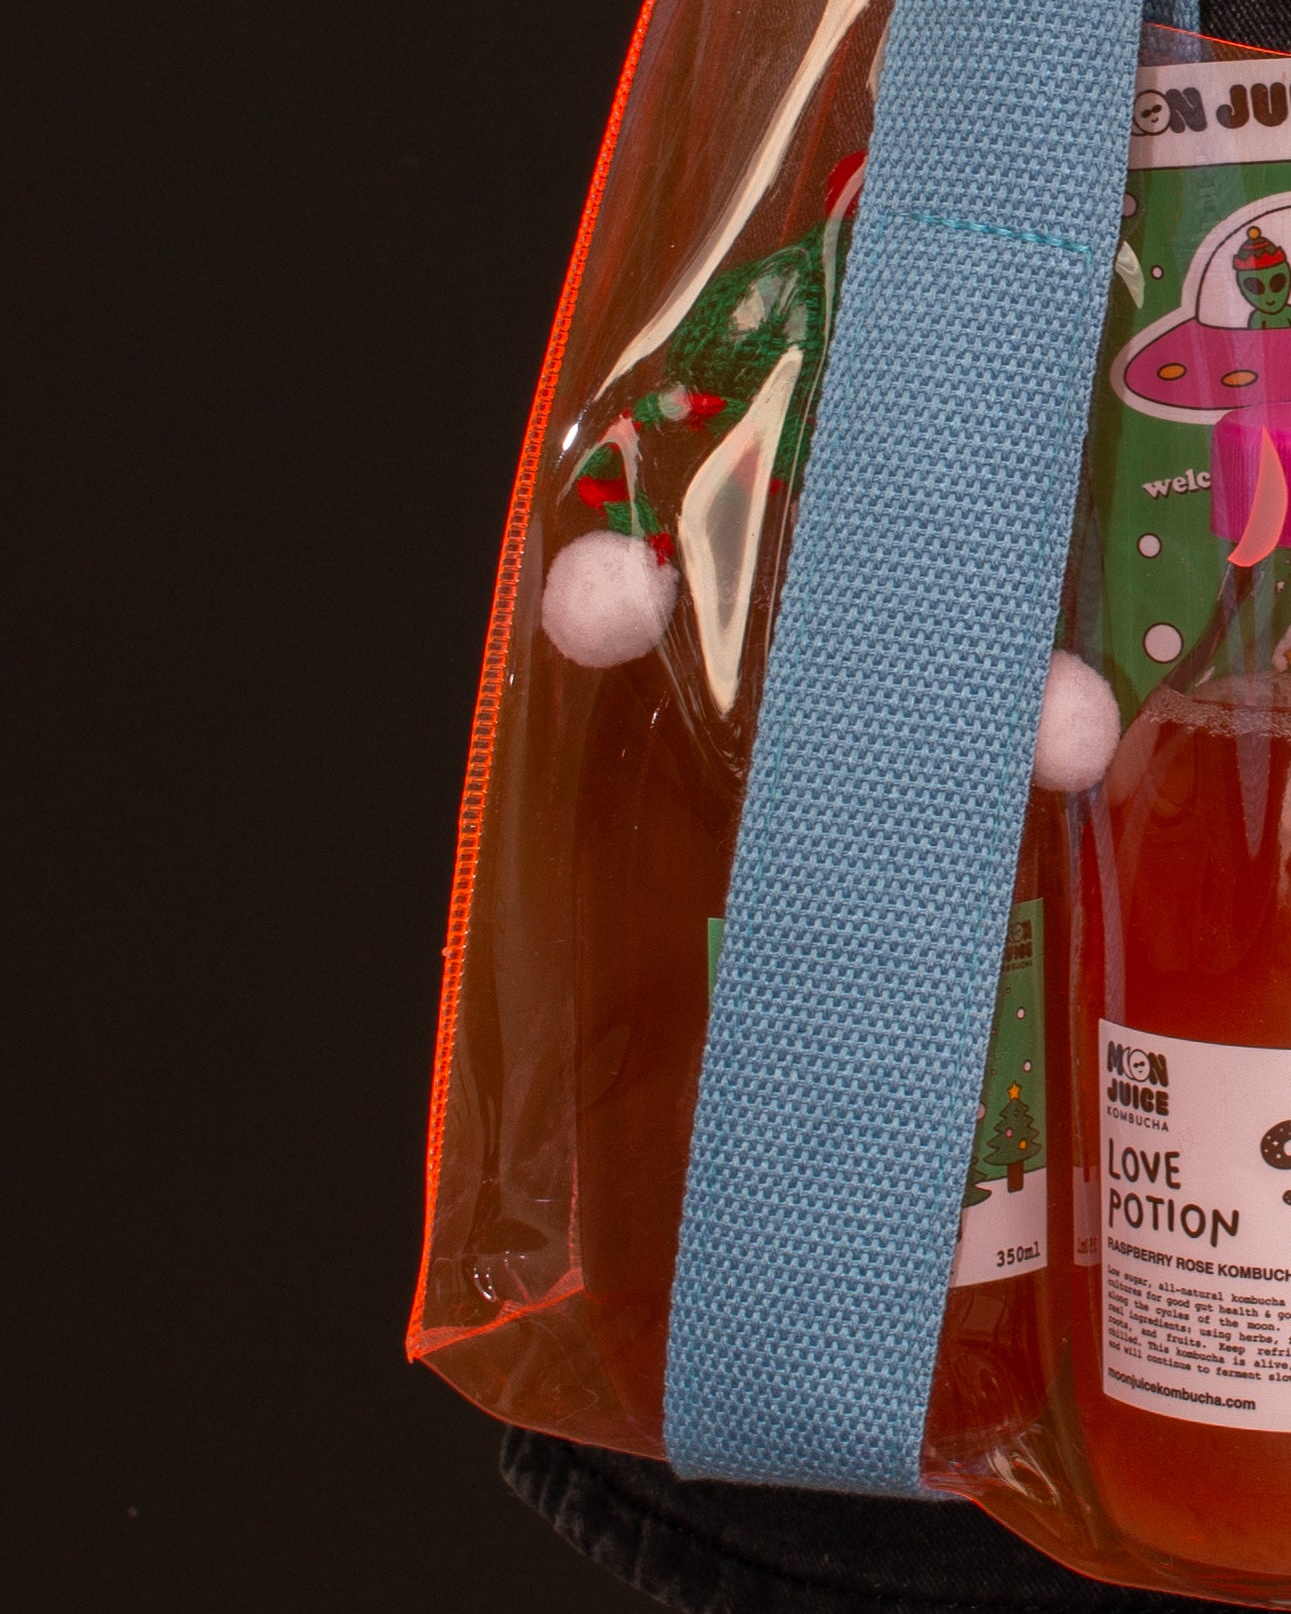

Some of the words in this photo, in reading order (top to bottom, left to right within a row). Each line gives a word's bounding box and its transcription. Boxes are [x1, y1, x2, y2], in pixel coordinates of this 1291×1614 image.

[1107, 1040, 1169, 1087] MOON
[1106, 1078, 1170, 1117] JUICE
[1107, 1105, 1170, 1132] KOMBUCHA
[1108, 1137, 1182, 1190] LOVE
[1108, 1187, 1240, 1248] POTION
[996, 1241, 1041, 1268] 350ml
[1107, 1237, 1173, 1267] RASPBERRY
[1176, 1257, 1214, 1275] ROSE
[1146, 1290, 1163, 1302] for
[1166, 1297, 1190, 1310] good
[1195, 1302, 1214, 1314] gut
[1219, 1305, 1259, 1318] health
[1264, 1310, 1271, 1318] &
[1158, 1282, 1224, 1301] all-natural
[1231, 1293, 1286, 1307] kombucha
[1134, 1300, 1149, 1312] the
[1155, 1306, 1190, 1321] cycles
[1197, 1315, 1211, 1324] of
[1219, 1316, 1239, 1328] the
[1247, 1322, 1281, 1332] moon.
[1141, 1327, 1157, 1339] and
[1166, 1333, 1207, 1349] fruits.
[1218, 1342, 1246, 1356] Keep
[1199, 1328, 1232, 1341] using
[1239, 1331, 1279, 1345] herbs,
[1123, 1346, 1143, 1360] will
[1146, 1353, 1192, 1371] continue
[1197, 1364, 1210, 1375] to
[1216, 1367, 1262, 1381] ferment
[1147, 1340, 1169, 1354] This
[1176, 1347, 1226, 1365] kombucha
[1233, 1356, 1246, 1367] is
[1108, 1367, 1256, 1410] moonjuicekombucha.com
